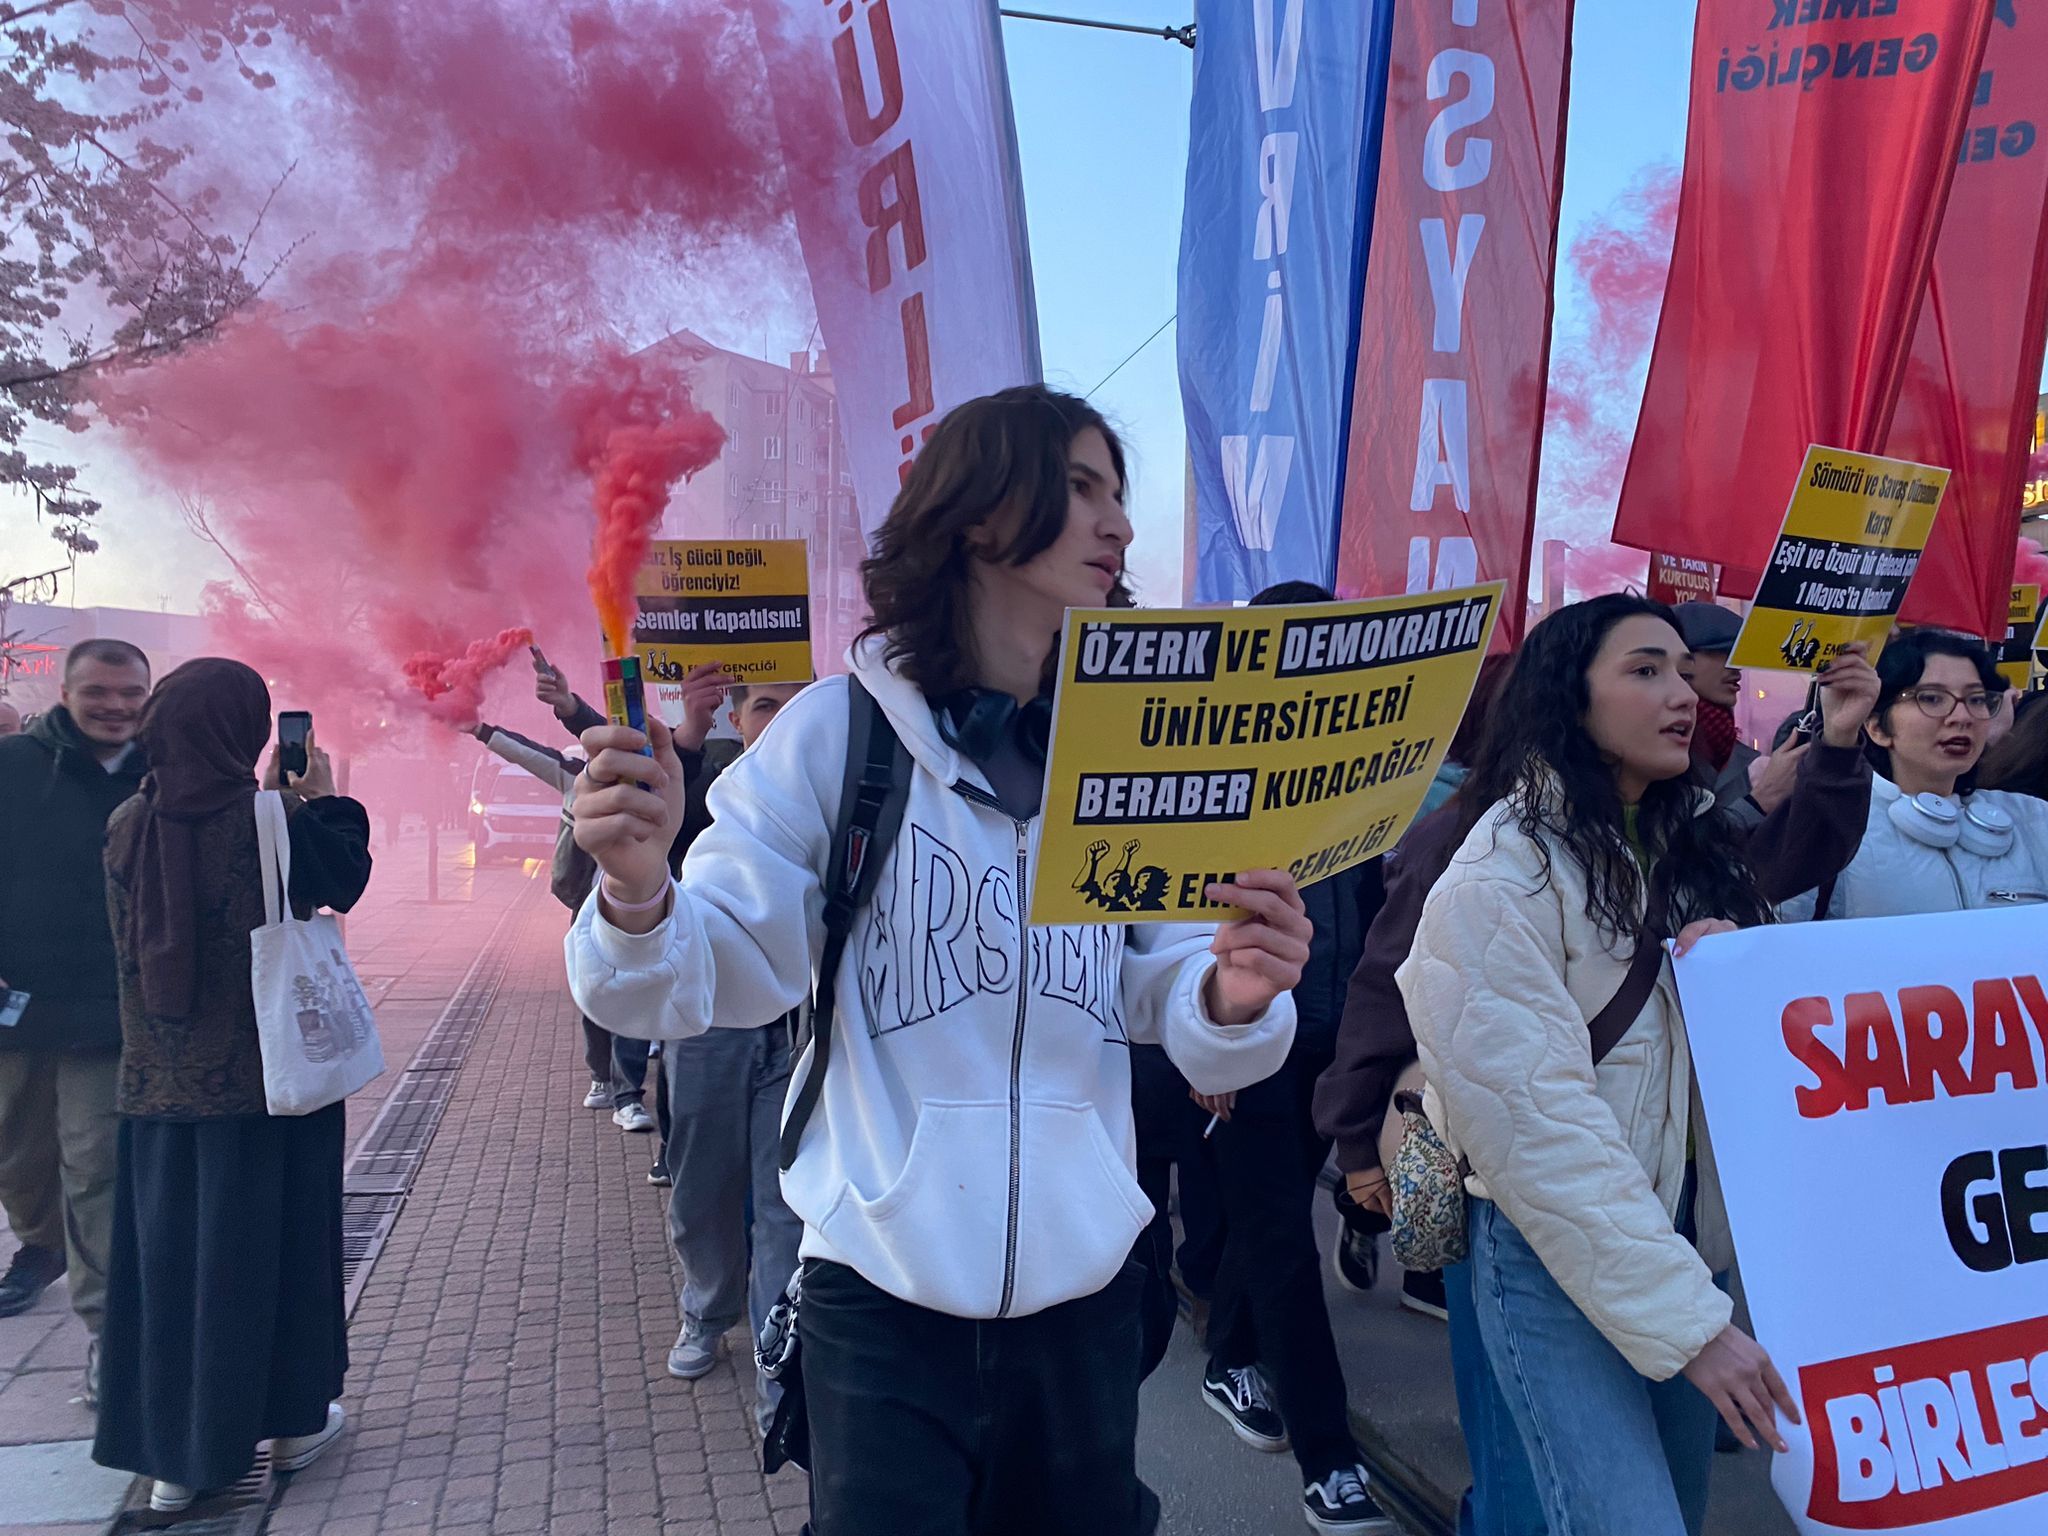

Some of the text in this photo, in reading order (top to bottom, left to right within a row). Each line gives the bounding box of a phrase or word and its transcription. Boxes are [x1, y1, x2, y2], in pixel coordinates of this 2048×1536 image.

[1810, 461, 1864, 496] Sömürü
[1863, 474, 1879, 496] ve
[1879, 473, 1908, 509] Savaş
[1864, 509, 1893, 544] Karşı
[669, 546, 682, 571] İş
[687, 548, 722, 566] Gücü
[727, 548, 767, 568] Değil,
[1774, 539, 1807, 574] Eşit
[1805, 548, 1825, 570] ve
[1825, 543, 1862, 576] Özgür
[1859, 550, 1878, 576] bir
[662, 572, 741, 592] Öğrenciyiz!
[1796, 581, 1808, 605] 1
[1804, 582, 1861, 611] Mayıs'ta
[704, 607, 802, 633] Kapatılsın!
[1081, 598, 1488, 676] ÖZERK VE DEMOKRATİK
[723, 661, 777, 674] GENÇLİĞİ
[1140, 675, 1415, 747] ÜNİVERSİTELERİ
[1078, 737, 1435, 818] BERABER KURACAĞIZ!
[1288, 814, 1399, 883] GENÇLİĞİ
